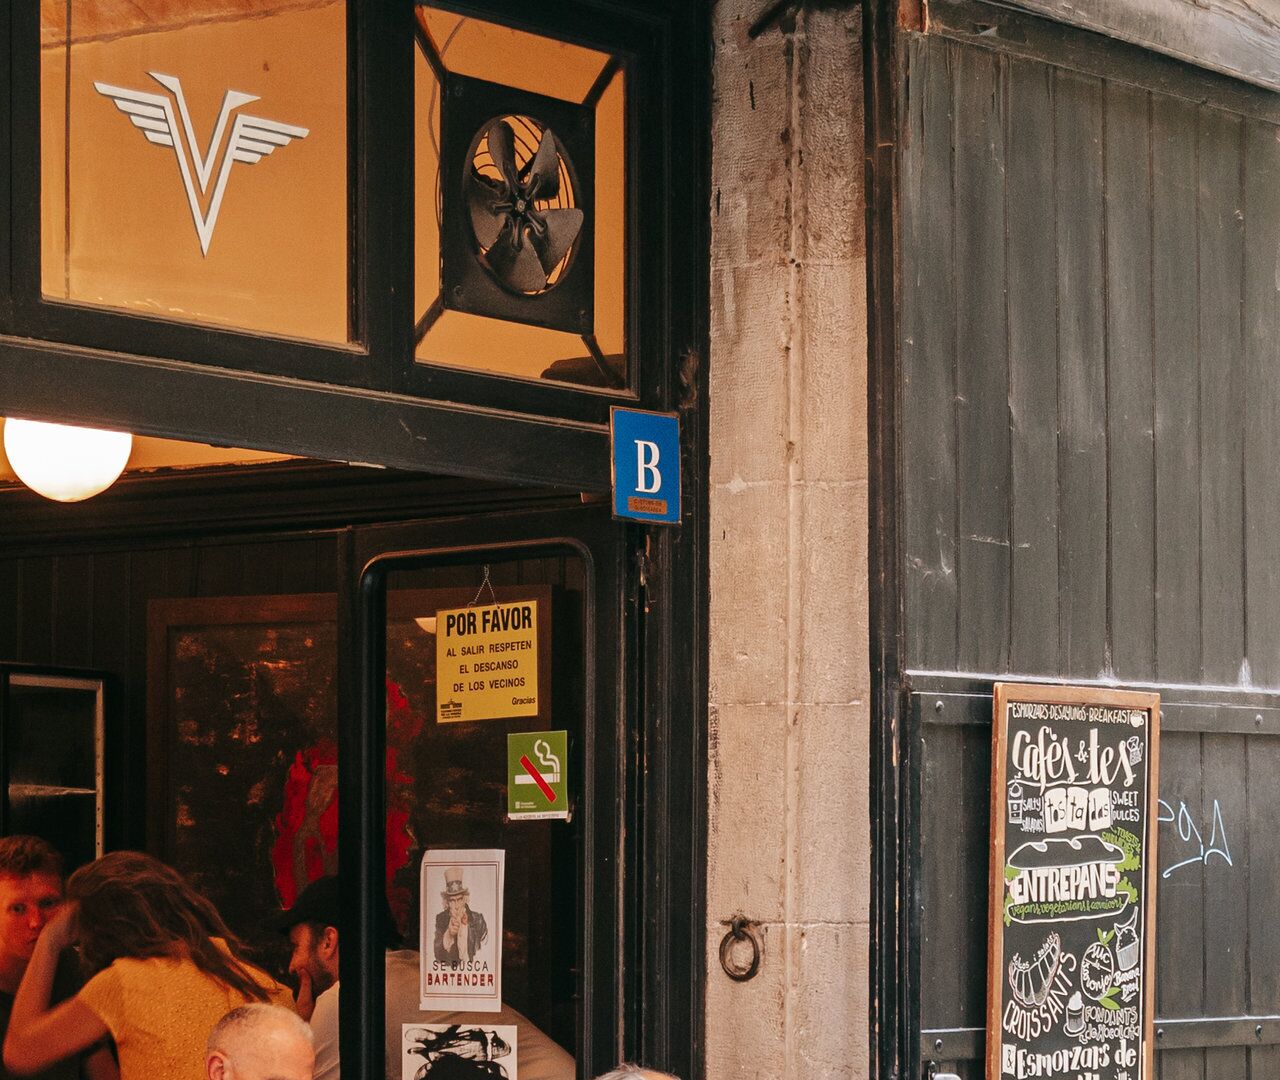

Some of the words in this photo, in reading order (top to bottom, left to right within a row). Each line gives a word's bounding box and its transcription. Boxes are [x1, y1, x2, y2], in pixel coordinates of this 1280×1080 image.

[634, 440, 661, 493] B
[446, 611, 477, 636] POR
[482, 606, 532, 634] FAVOR
[446, 647, 457, 658] AL
[461, 645, 485, 657] SALIR
[489, 640, 532, 653] RESPETEN
[459, 665, 470, 674] EL
[474, 660, 519, 672] DESCANSO
[453, 683, 464, 692] DE
[469, 680, 485, 691] LOS
[489, 677, 525, 689] VECINOS
[511, 696, 536, 706] Gracias
[1112, 791, 1139, 807] SWEET
[1112, 808, 1140, 822] DULCES
[1013, 863, 1117, 904] ENTREPANS
[432, 961, 446, 971] SE
[451, 960, 489, 972] BUSCA
[427, 973, 494, 987] BARTENDER
[1003, 952, 1077, 1042] CROISSANTS
[1085, 1006, 1138, 1026] FONDANTS
[1017, 1043, 1110, 1080] Esmorzars
[1115, 1040, 1137, 1068] de
